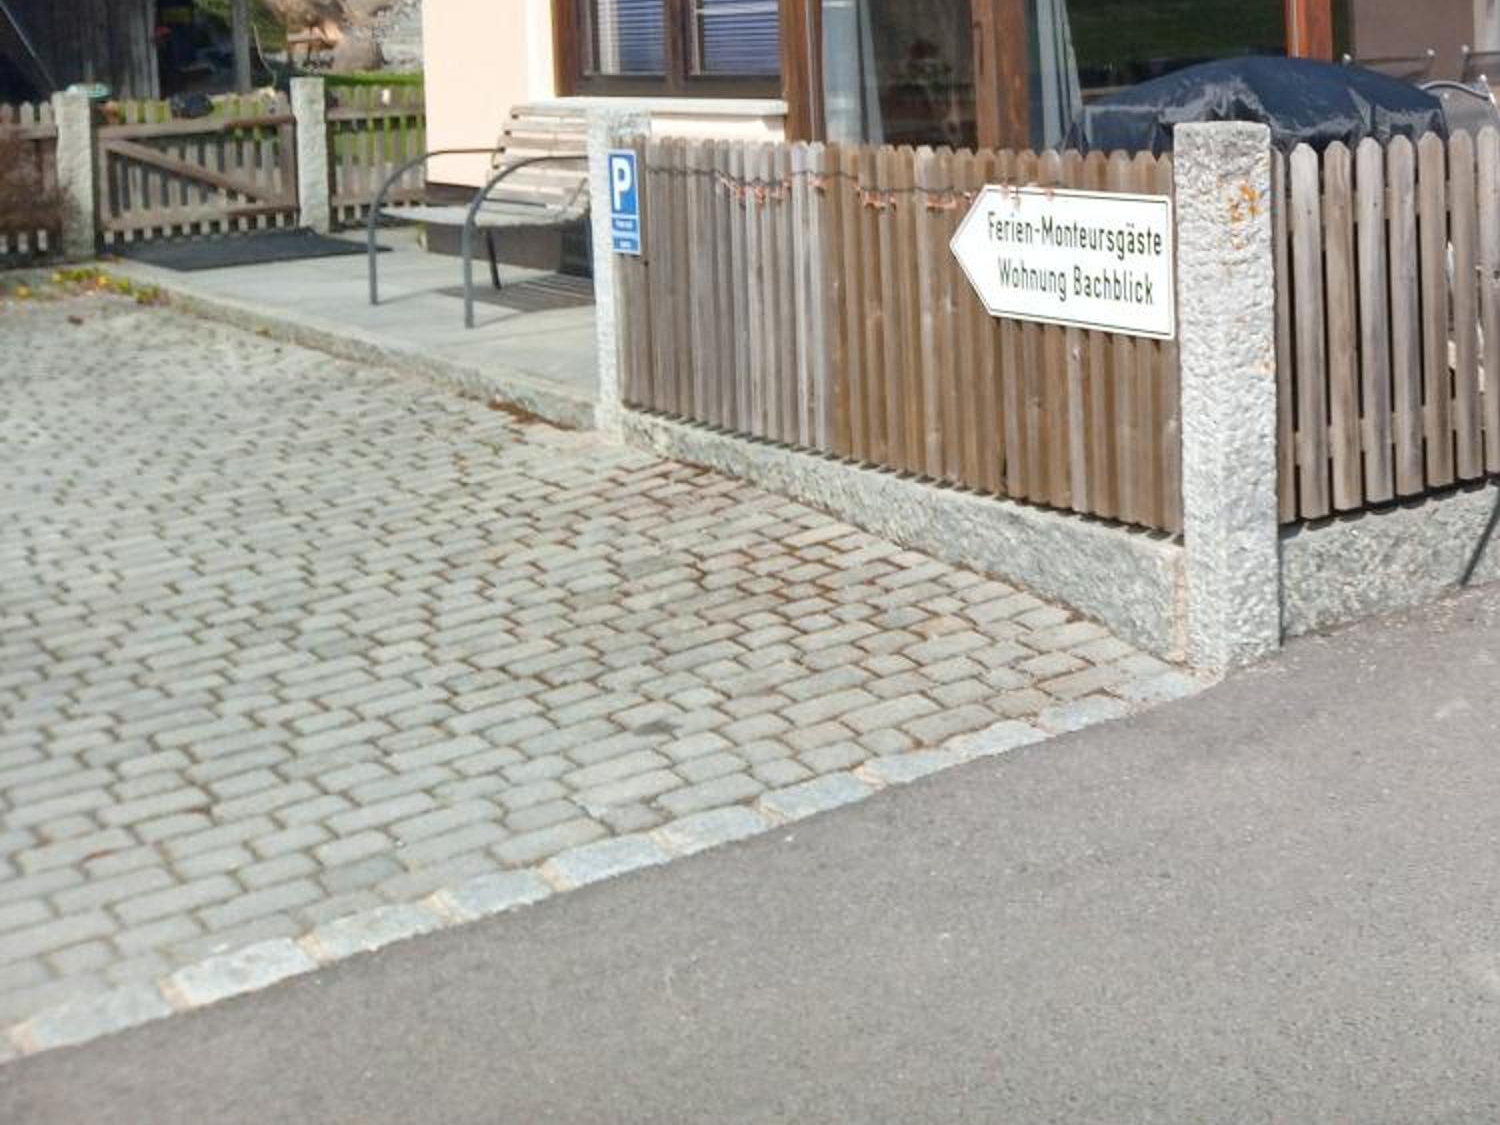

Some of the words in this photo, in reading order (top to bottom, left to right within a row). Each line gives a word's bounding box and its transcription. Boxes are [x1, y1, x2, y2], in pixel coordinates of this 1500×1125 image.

[611, 156, 633, 211] P
[987, 210, 1163, 262] Ferien-Monteursgäste
[998, 257, 1068, 302] Wohnung
[1073, 264, 1154, 305] Bachblick
